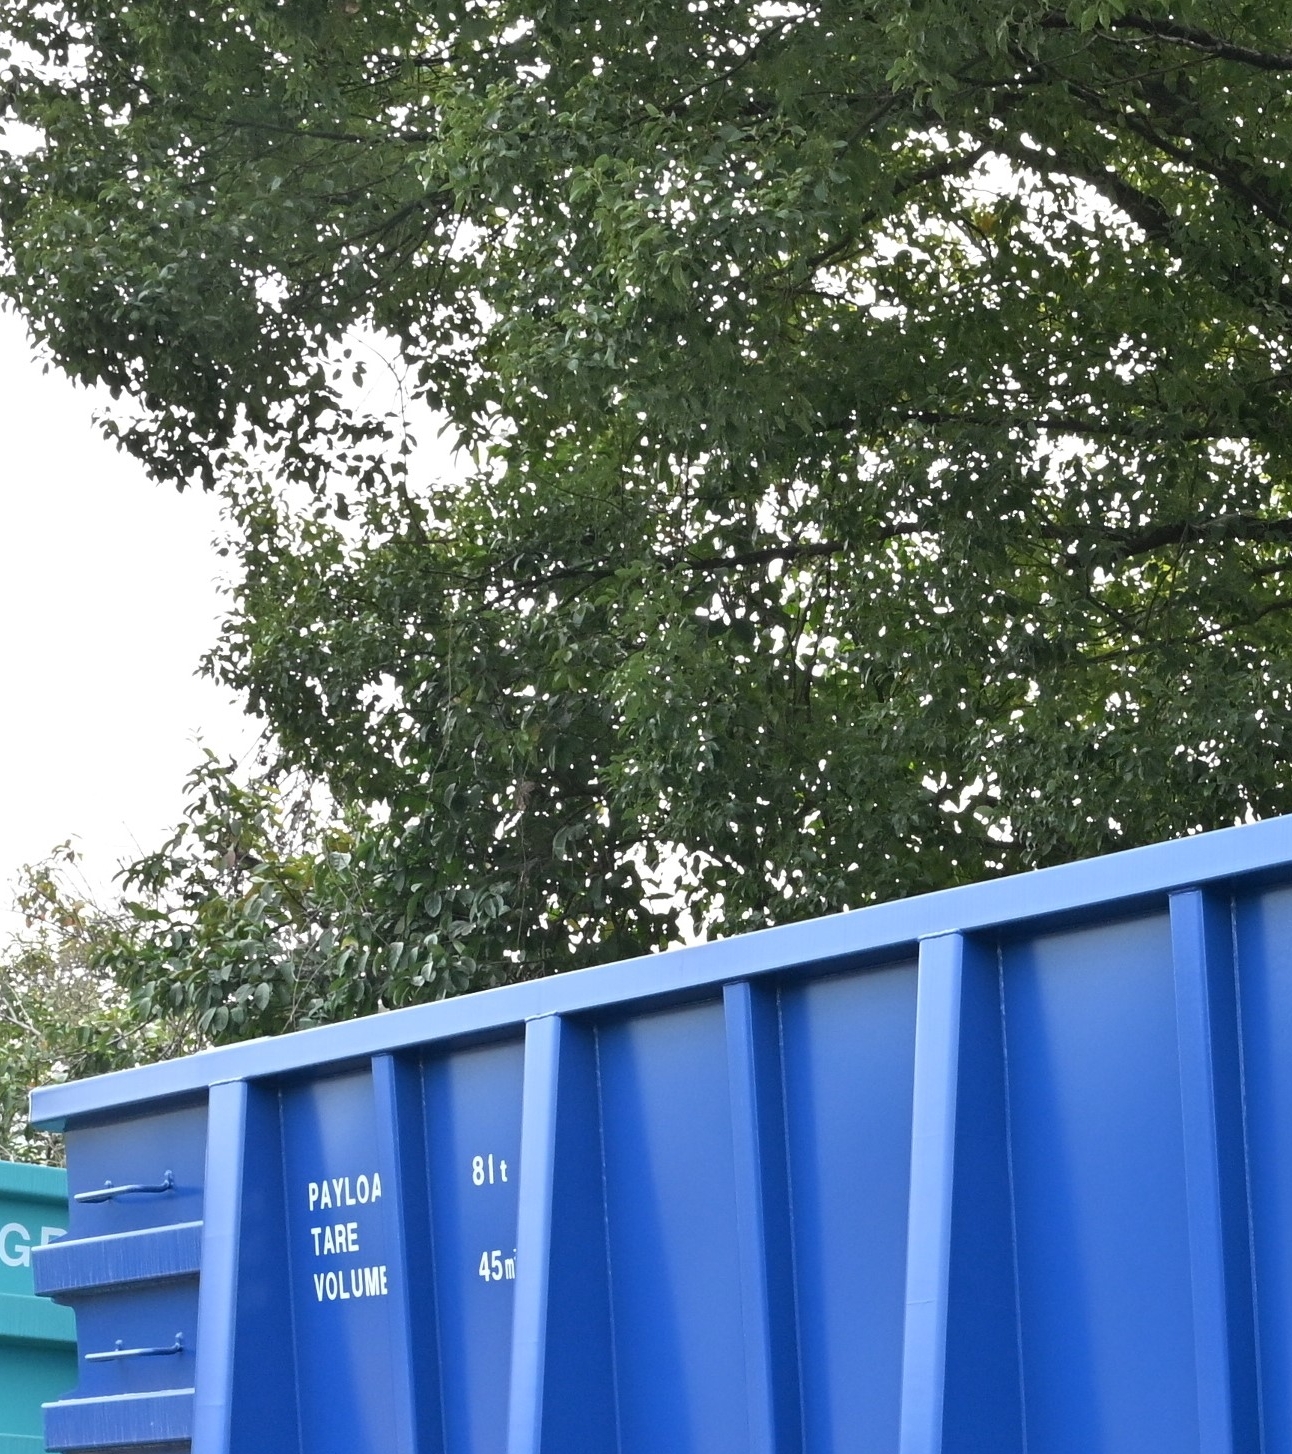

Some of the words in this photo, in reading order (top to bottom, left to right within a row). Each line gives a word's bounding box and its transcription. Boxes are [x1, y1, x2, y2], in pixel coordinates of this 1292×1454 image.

[310, 1222, 360, 1256] TARE
[478, 1248, 517, 1282] 45m
[313, 1265, 388, 1302] VOLUME
